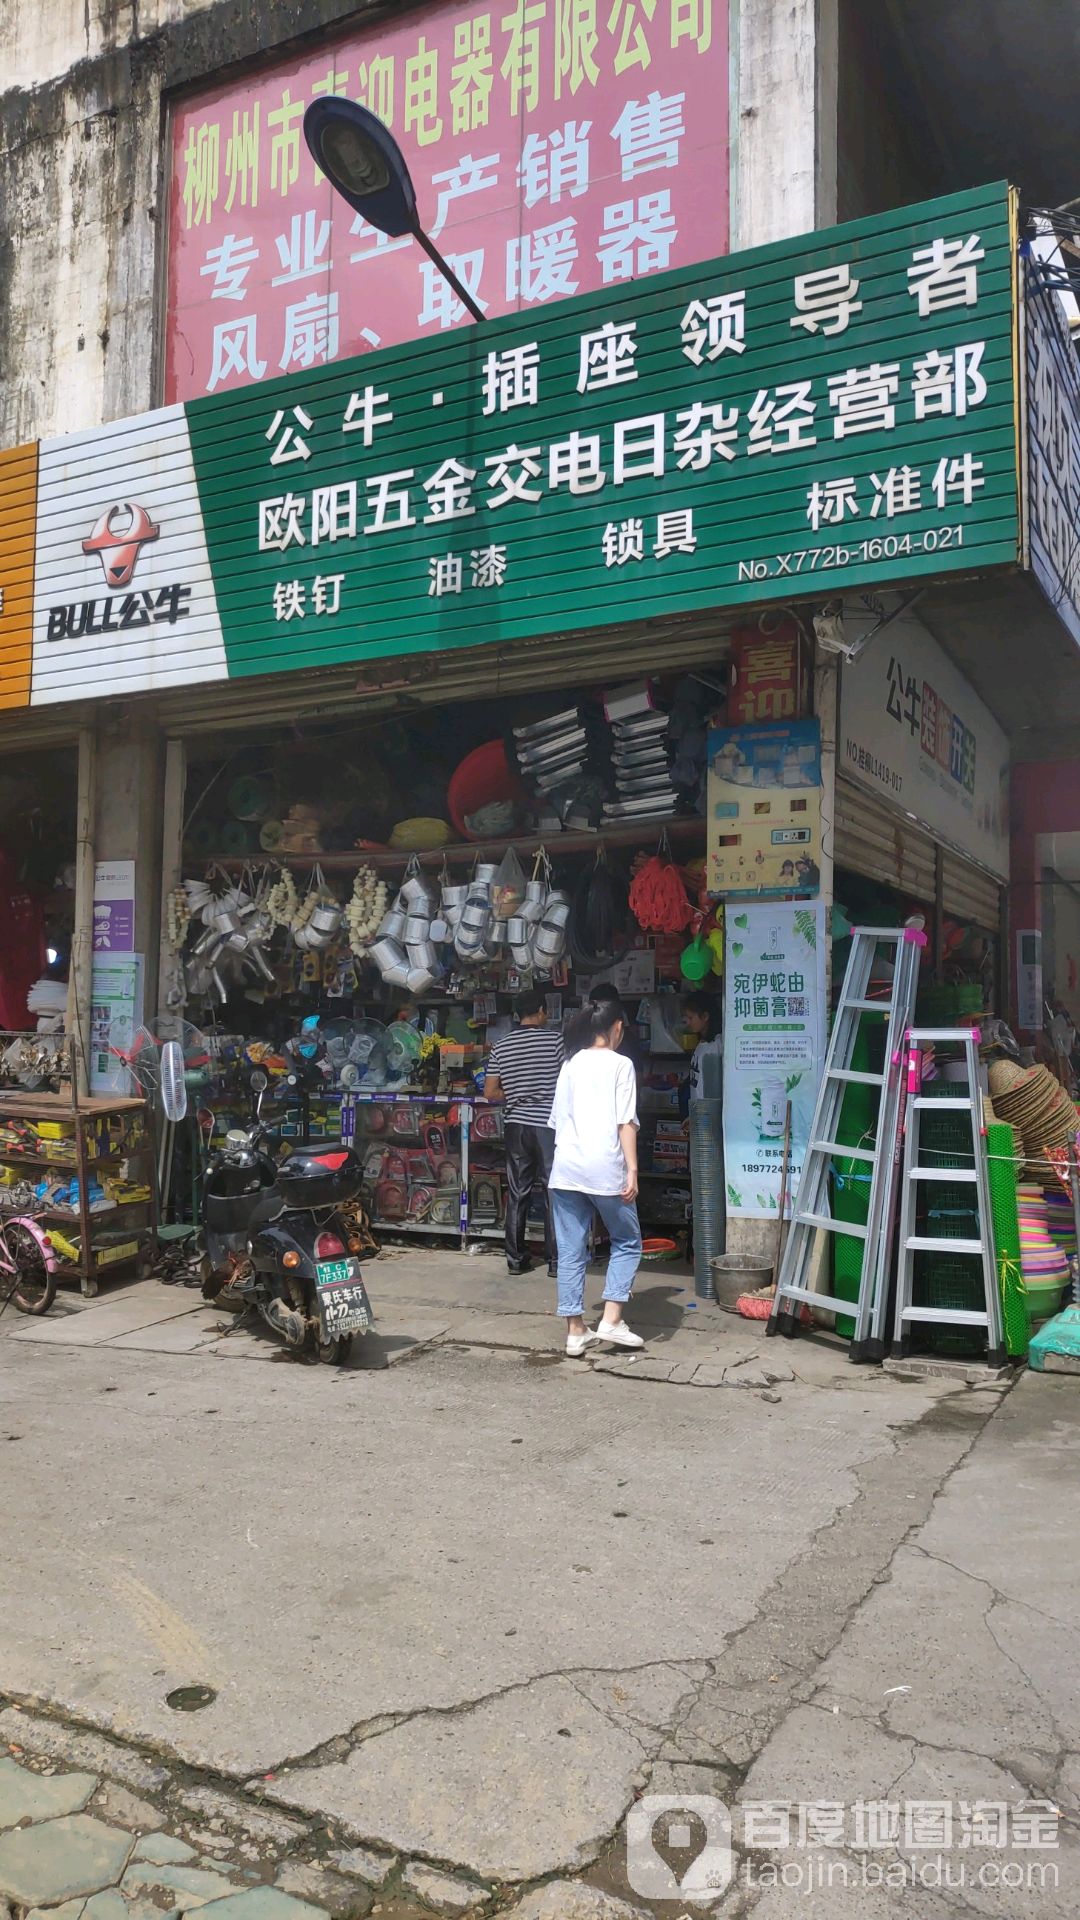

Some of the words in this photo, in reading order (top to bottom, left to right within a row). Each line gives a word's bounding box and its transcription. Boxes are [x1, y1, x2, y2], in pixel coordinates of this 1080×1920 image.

[182, 0, 714, 229] 柳州市迎电器有限公司
[206, 189, 679, 391] 风扇、取暖器
[258, 341, 987, 551] 欧阳五金交电日杂经营部
[272, 575, 345, 621] 铁钉
[428, 544, 507, 597] 油漆
[601, 508, 697, 568] 锁具
[806, 452, 985, 533] 标准件
[737, 524, 965, 581] No.X772b-1604-021
[734, 972, 804, 994] 宛伊蛇由
[734, 996, 787, 1018] 抑菌膏
